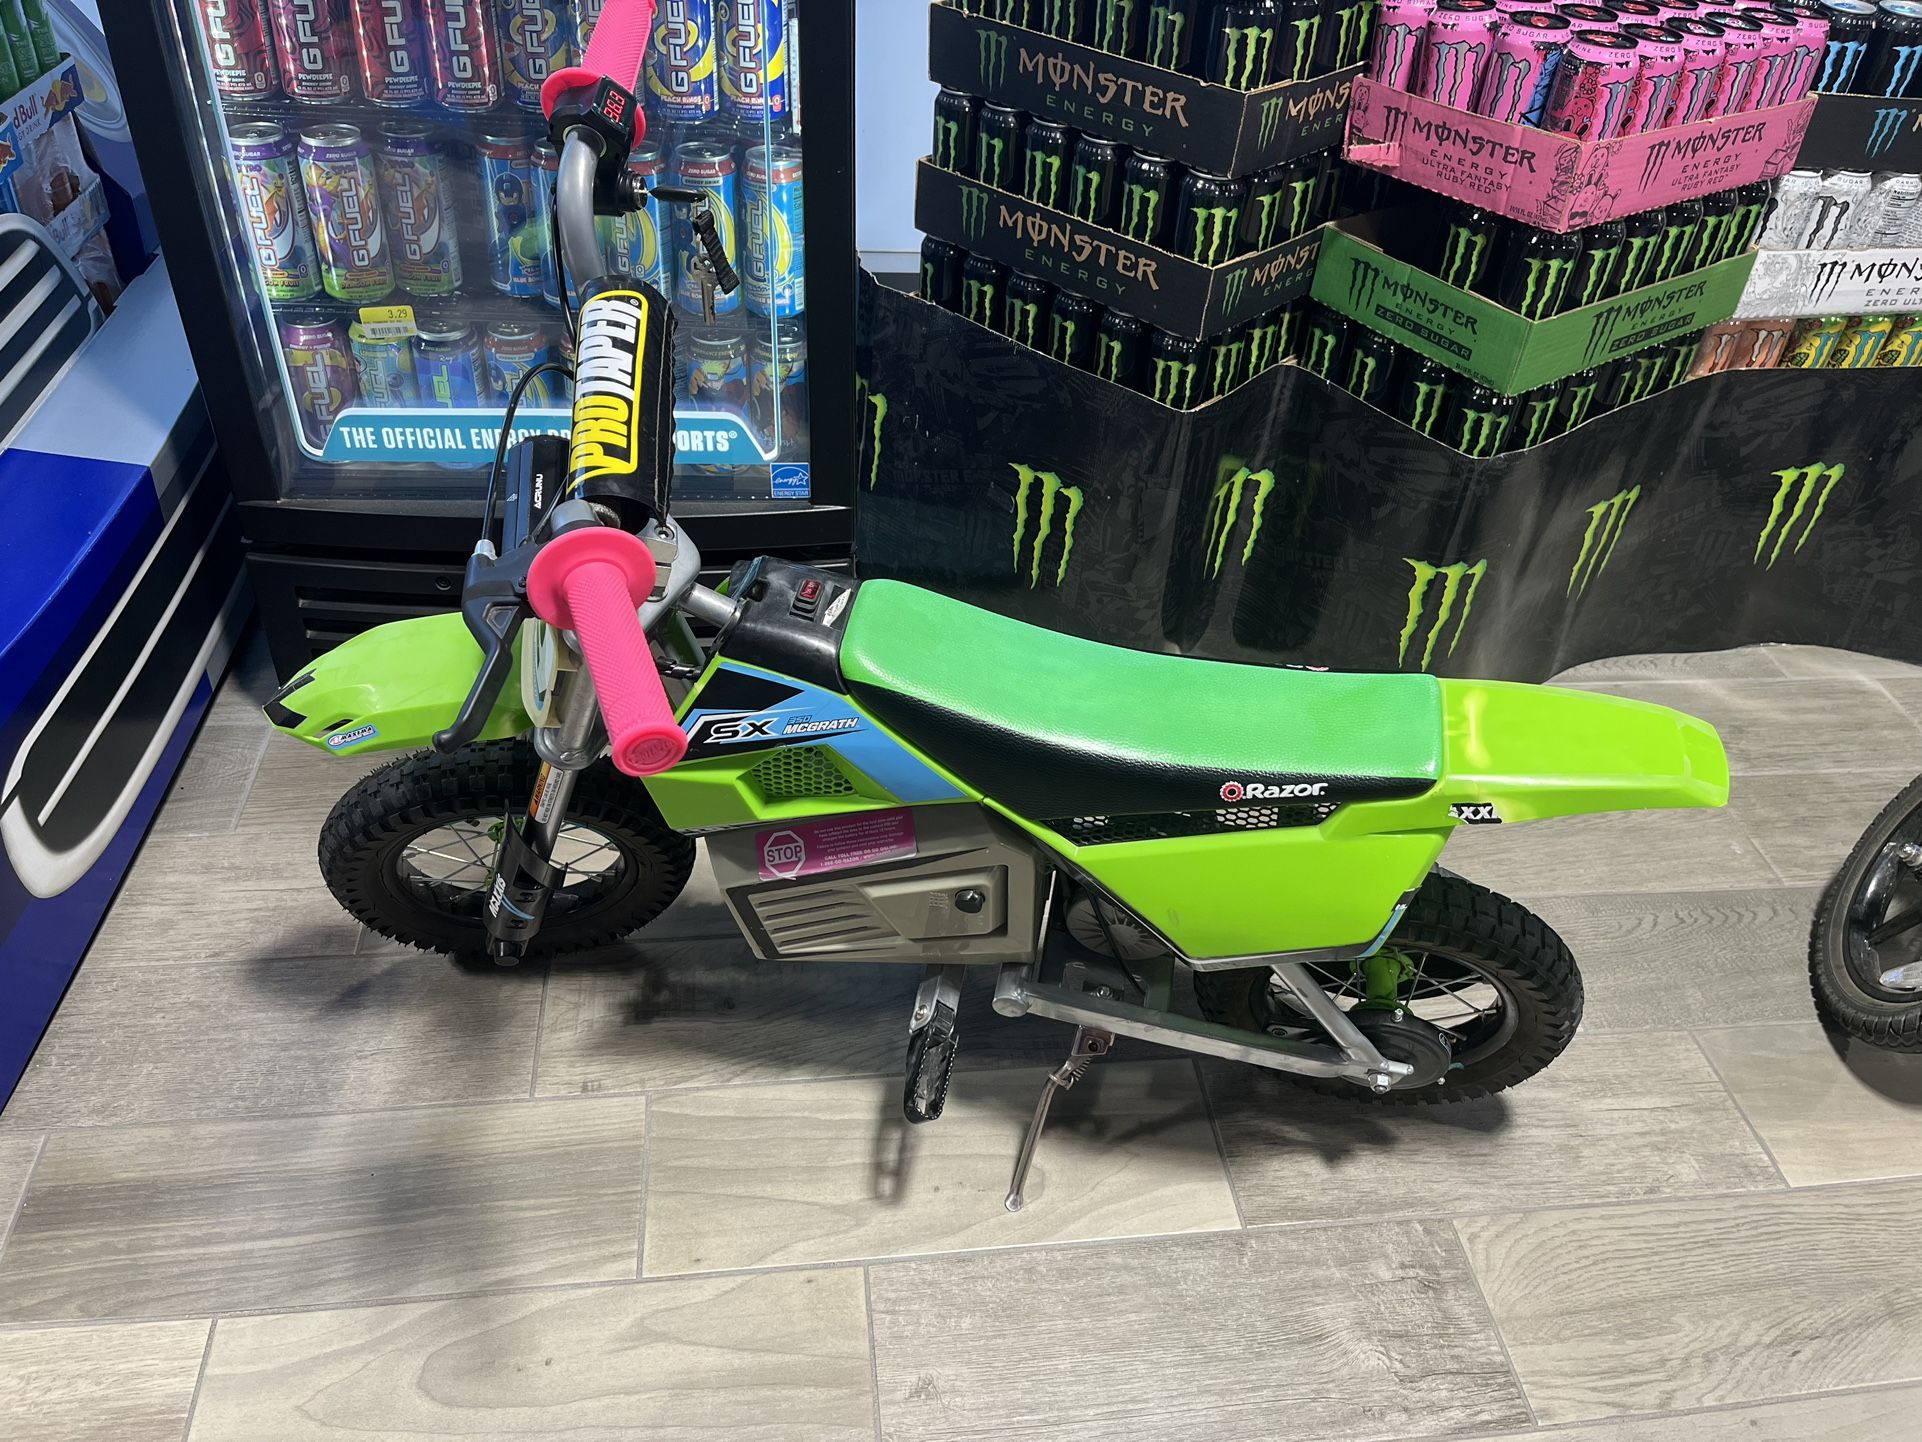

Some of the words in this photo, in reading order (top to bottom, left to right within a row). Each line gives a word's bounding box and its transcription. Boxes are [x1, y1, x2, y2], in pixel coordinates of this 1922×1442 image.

[1285, 81, 1351, 123] MONS
[1045, 94, 1154, 137] ENERGY
[1300, 113, 1344, 136] ENER
[1422, 158, 1457, 176] ULTRA
[1460, 169, 1511, 193] FANTASY
[1430, 148, 1508, 180] ENERGY
[1671, 173, 1700, 187] ULTRA
[1702, 162, 1741, 181] FANTASY
[1681, 152, 1743, 174] ENERGY
[1436, 170, 1465, 187] RUBY
[1680, 179, 1706, 192] RUBY
[1024, 248, 1127, 296] ENERGY
[1251, 241, 1321, 288] MONST
[1263, 267, 1314, 296] ENERG
[1865, 287, 1922, 297] ENER
[387, 309, 408, 319] 3.29
[1864, 298, 1898, 307] ZERO
[1395, 303, 1455, 336] ENERGY
[1631, 307, 1686, 329] ENERGY
[1376, 306, 1415, 330] ZERO
[1419, 328, 1471, 358] SUGAR
[1611, 330, 1646, 350] ZERO
[1650, 315, 1695, 338] SUGAR
[339, 427, 378, 448] THE
[381, 426, 467, 449] OFFICIAL
[703, 717, 780, 744] SX
[782, 717, 859, 735] MCGRATH
[767, 844, 802, 863] STOP
